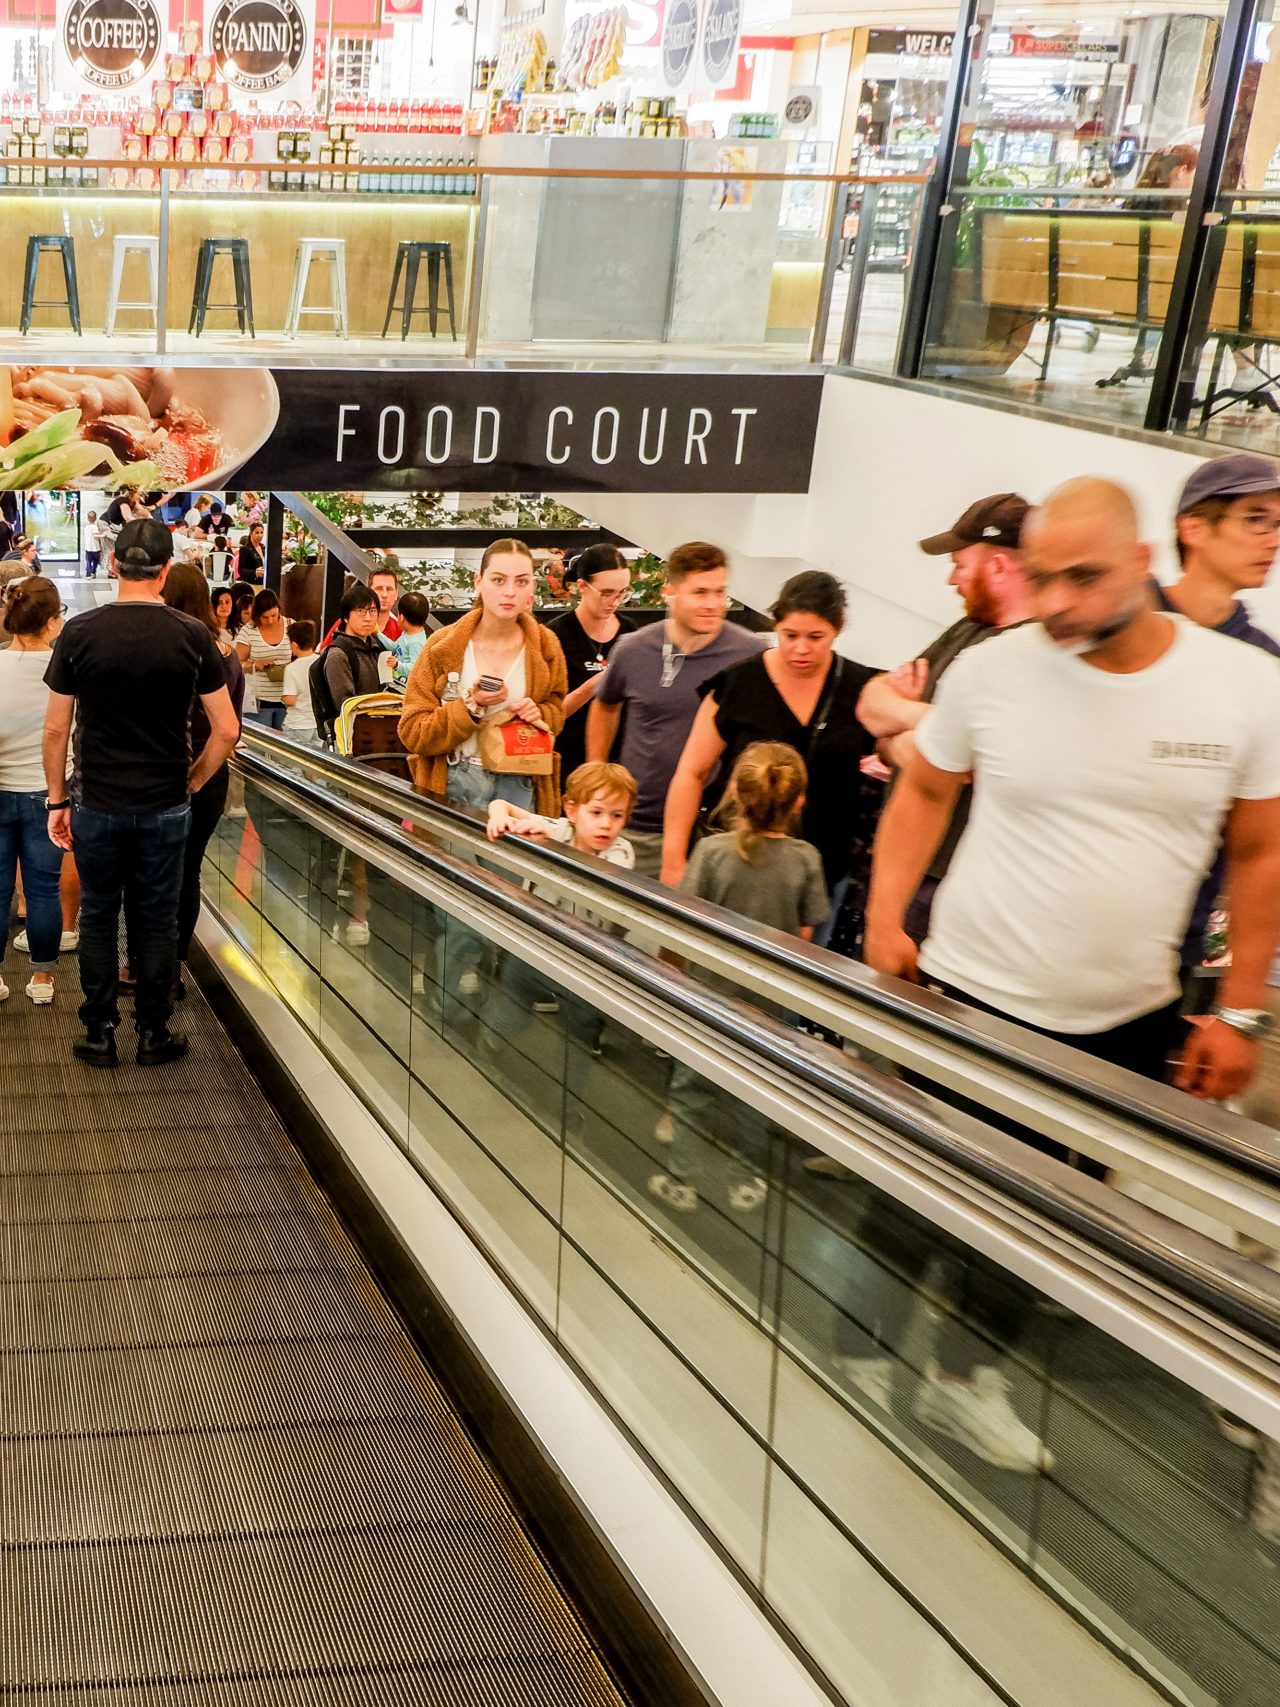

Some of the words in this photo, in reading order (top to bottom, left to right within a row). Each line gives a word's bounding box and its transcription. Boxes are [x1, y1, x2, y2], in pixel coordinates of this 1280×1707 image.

[80, 17, 144, 48] COFFEE
[228, 21, 289, 52] PANINI
[336, 404, 500, 465] FOOD
[545, 405, 758, 465] COURT
